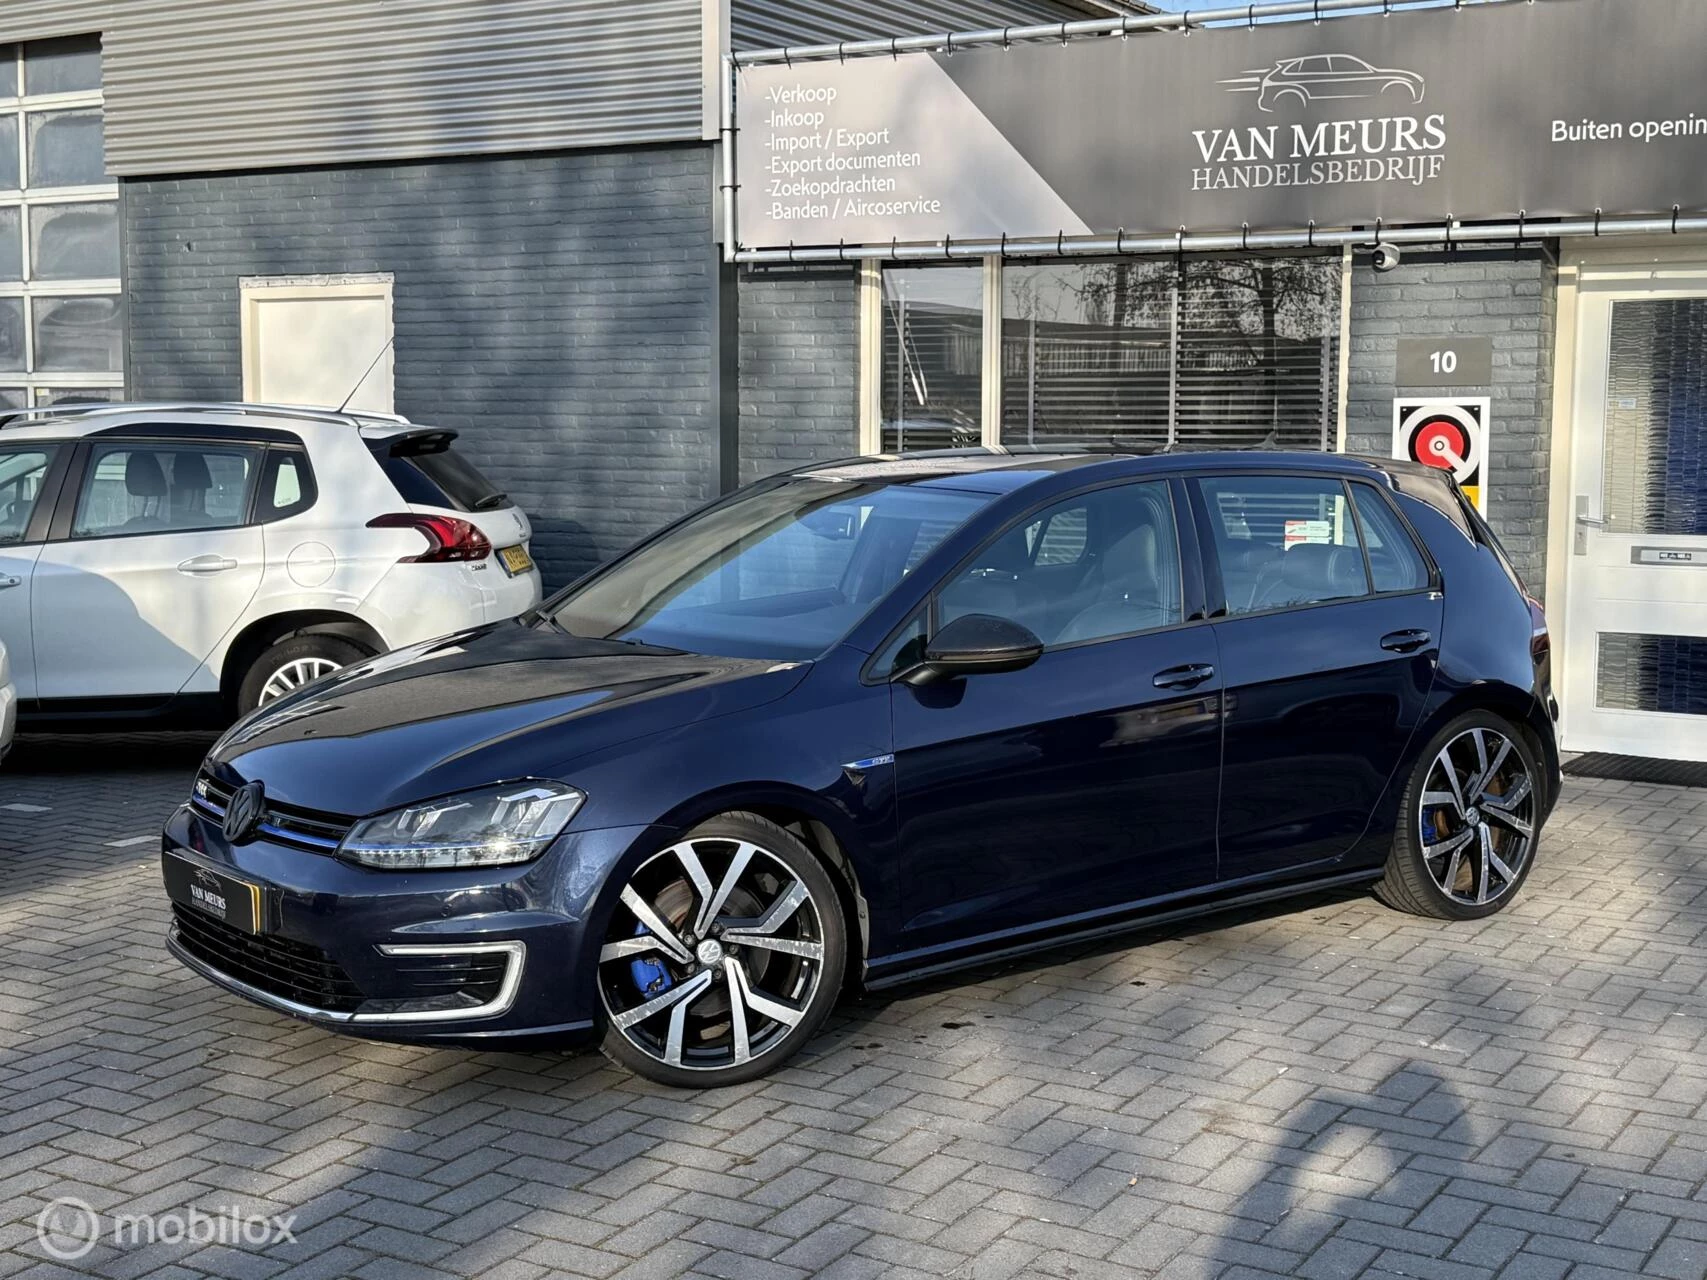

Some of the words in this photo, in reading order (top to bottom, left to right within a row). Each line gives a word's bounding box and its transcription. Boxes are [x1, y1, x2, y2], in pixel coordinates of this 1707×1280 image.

[764, 83, 837, 105] -Verkoop
[764, 107, 824, 130] -Inkoop
[1551, 118, 1622, 141] Buiten
[1628, 112, 1707, 143] openin
[764, 131, 822, 154] -Import
[824, 128, 833, 150] /
[836, 128, 890, 150] Export
[1191, 125, 1279, 163] VAN
[1290, 114, 1446, 158] MEURS
[764, 155, 822, 177] -Export
[825, 151, 921, 171] documenten
[1191, 154, 1445, 191] HANDELSBEDRIJF
[764, 173, 896, 199] -Zoekopdrachten
[765, 201, 828, 220] -Banden
[831, 198, 841, 219] /
[843, 196, 941, 217] Aircoservice
[1430, 350, 1457, 373] 10
